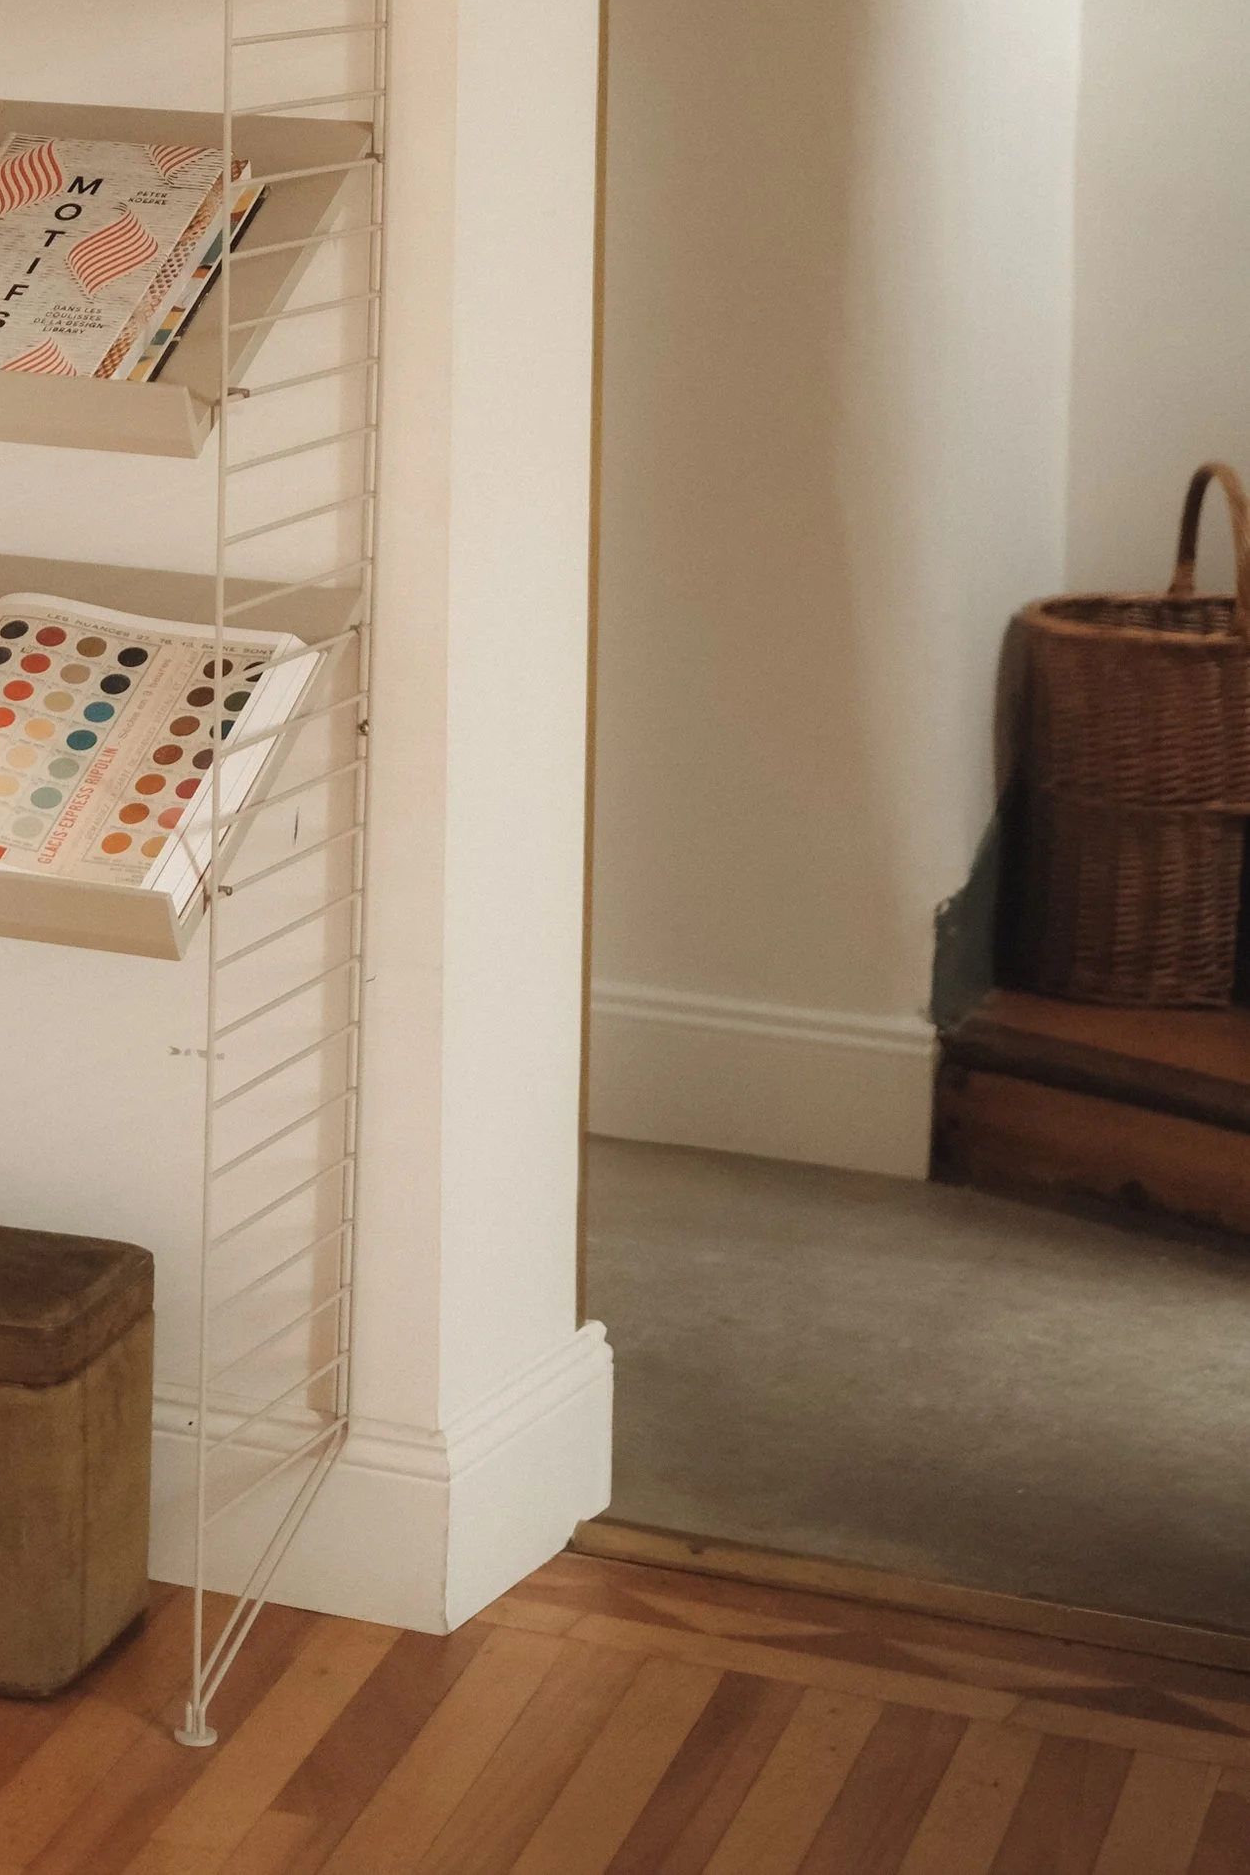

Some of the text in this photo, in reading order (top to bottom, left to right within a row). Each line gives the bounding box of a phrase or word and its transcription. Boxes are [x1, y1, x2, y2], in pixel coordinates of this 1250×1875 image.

[53, 305, 81, 313] DANS
[45, 311, 103, 322] COULISSES
[65, 320, 104, 329] DESIGN
[42, 326, 86, 334] LIBRARY
[75, 619, 130, 637] NUANCES
[38, 786, 94, 864] GLACIS-EXPRESS
[85, 747, 118, 785] RIPOLIN
